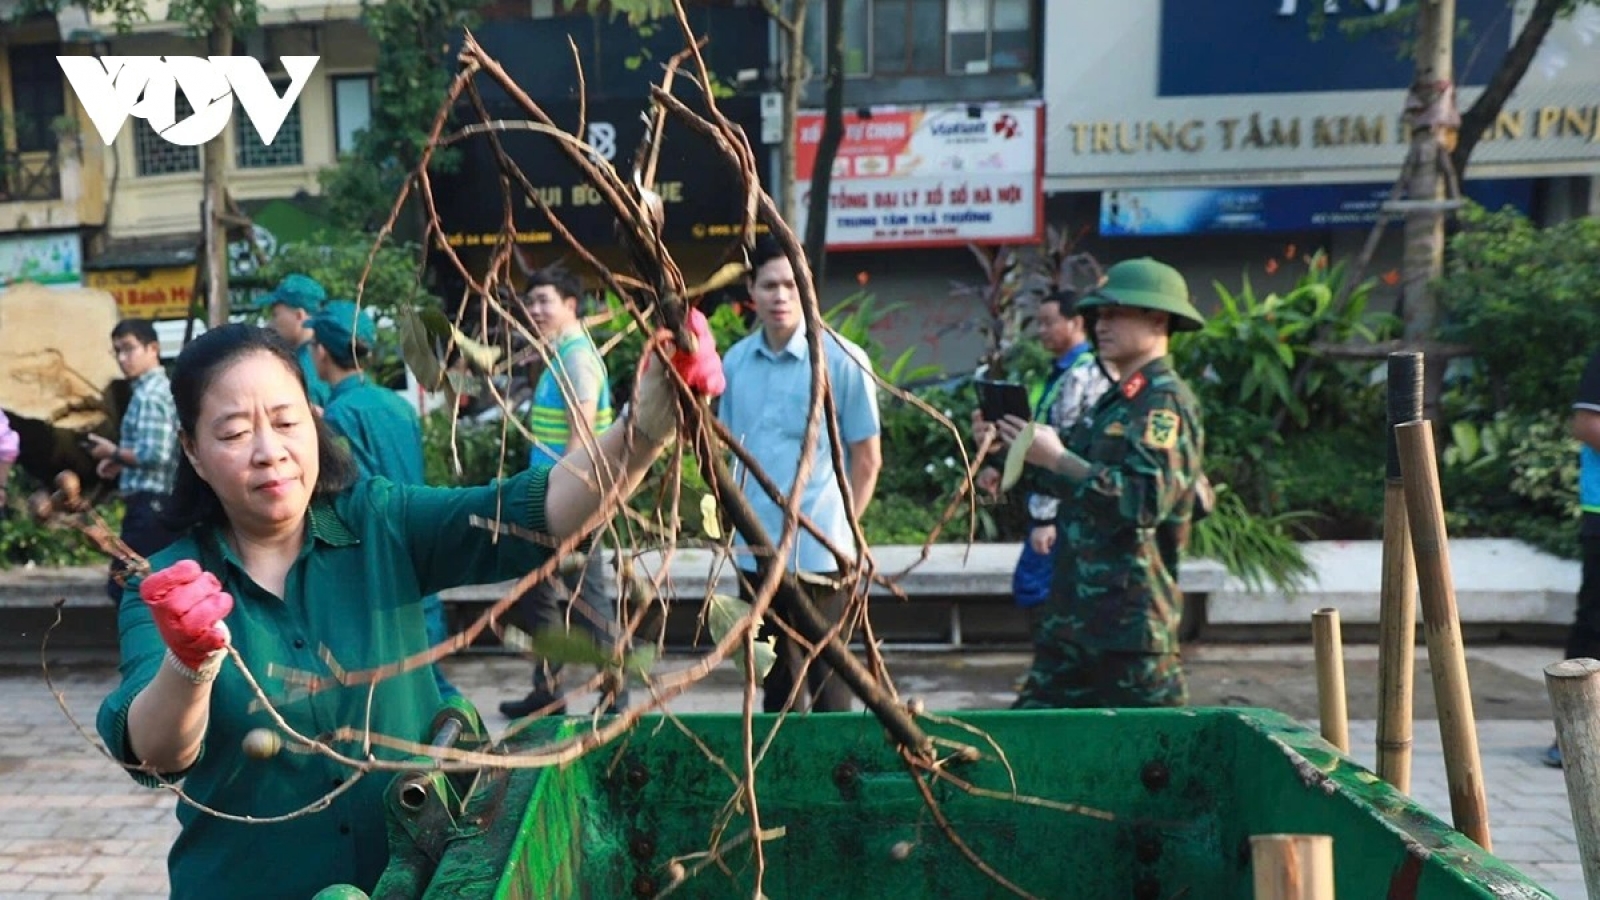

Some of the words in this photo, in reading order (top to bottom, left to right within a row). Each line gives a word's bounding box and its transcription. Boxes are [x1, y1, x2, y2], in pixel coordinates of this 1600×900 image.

[1069, 119, 1205, 155] TRUNG
[1217, 111, 1300, 150] TÂM
[1312, 113, 1388, 148] KIM
